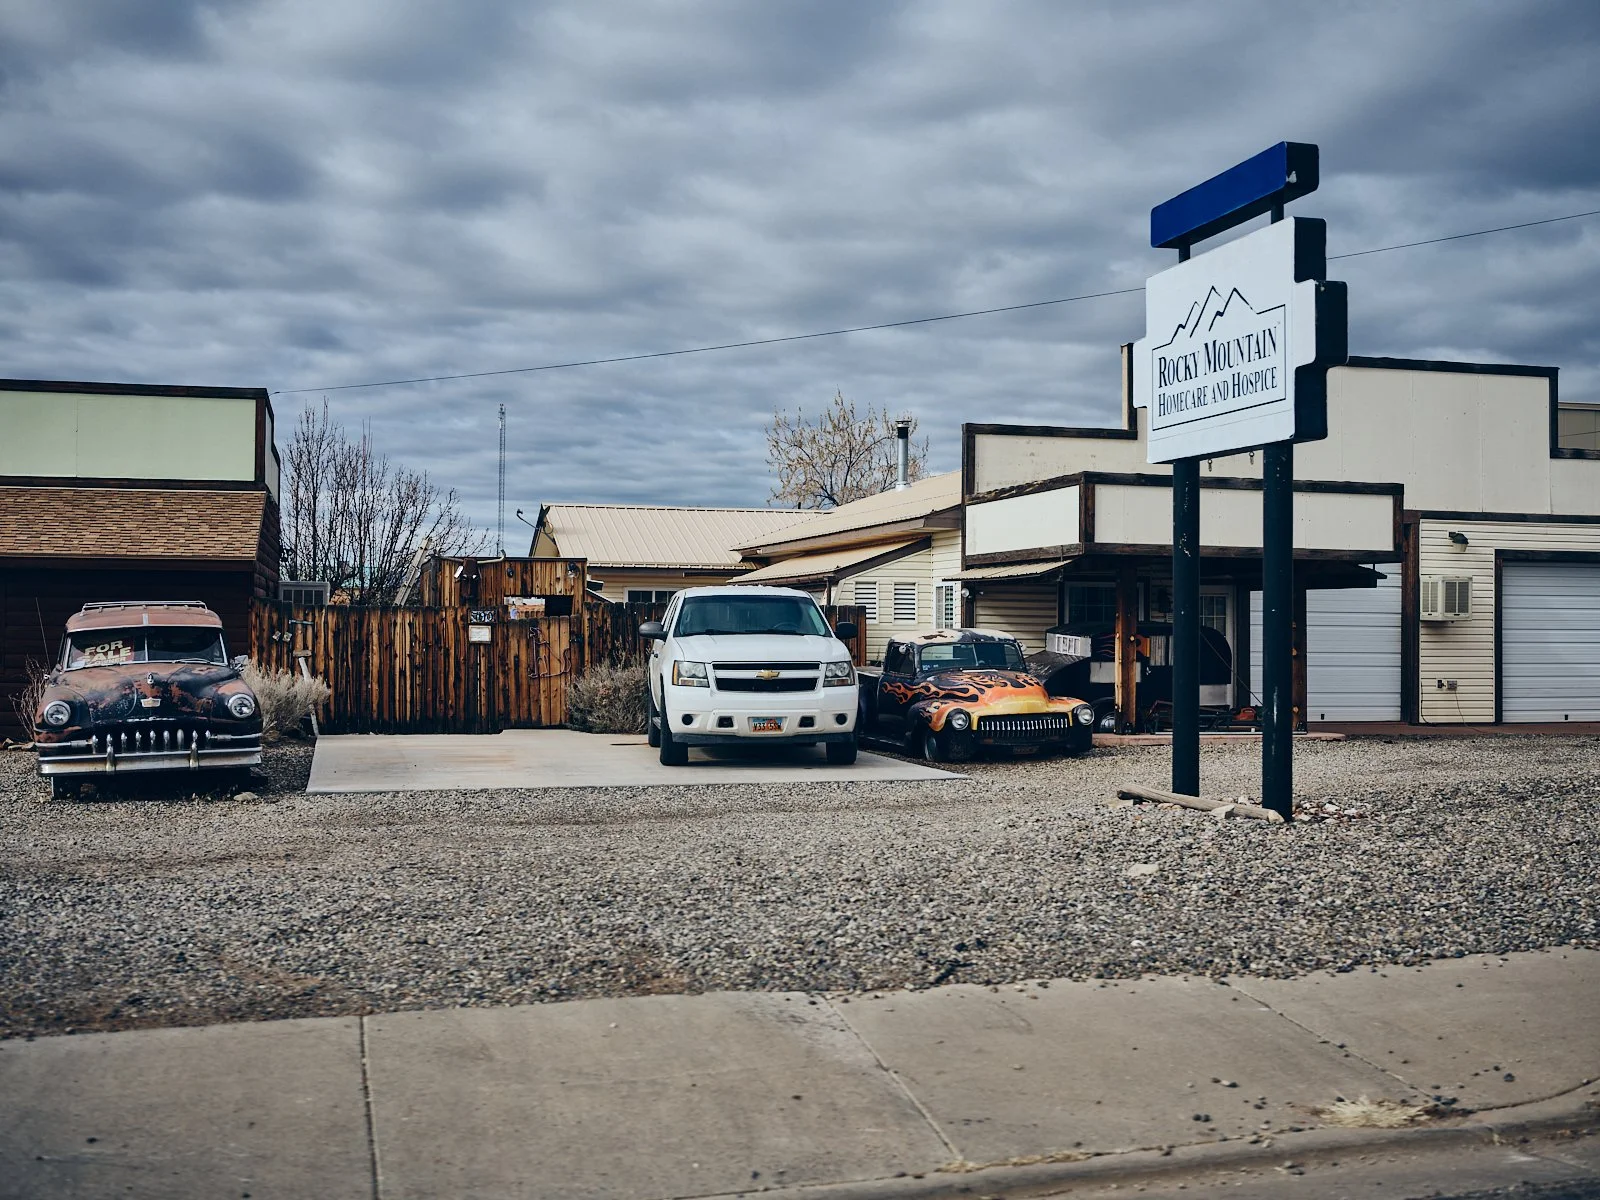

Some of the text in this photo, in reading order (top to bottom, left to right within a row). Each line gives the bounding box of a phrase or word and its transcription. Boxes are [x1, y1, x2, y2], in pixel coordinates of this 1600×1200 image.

[1158, 326, 1277, 389] ROCKY MOUNTAIN
[1158, 366, 1277, 417] HOMECARE AND HOSPICE
[85, 640, 123, 656] FOR
